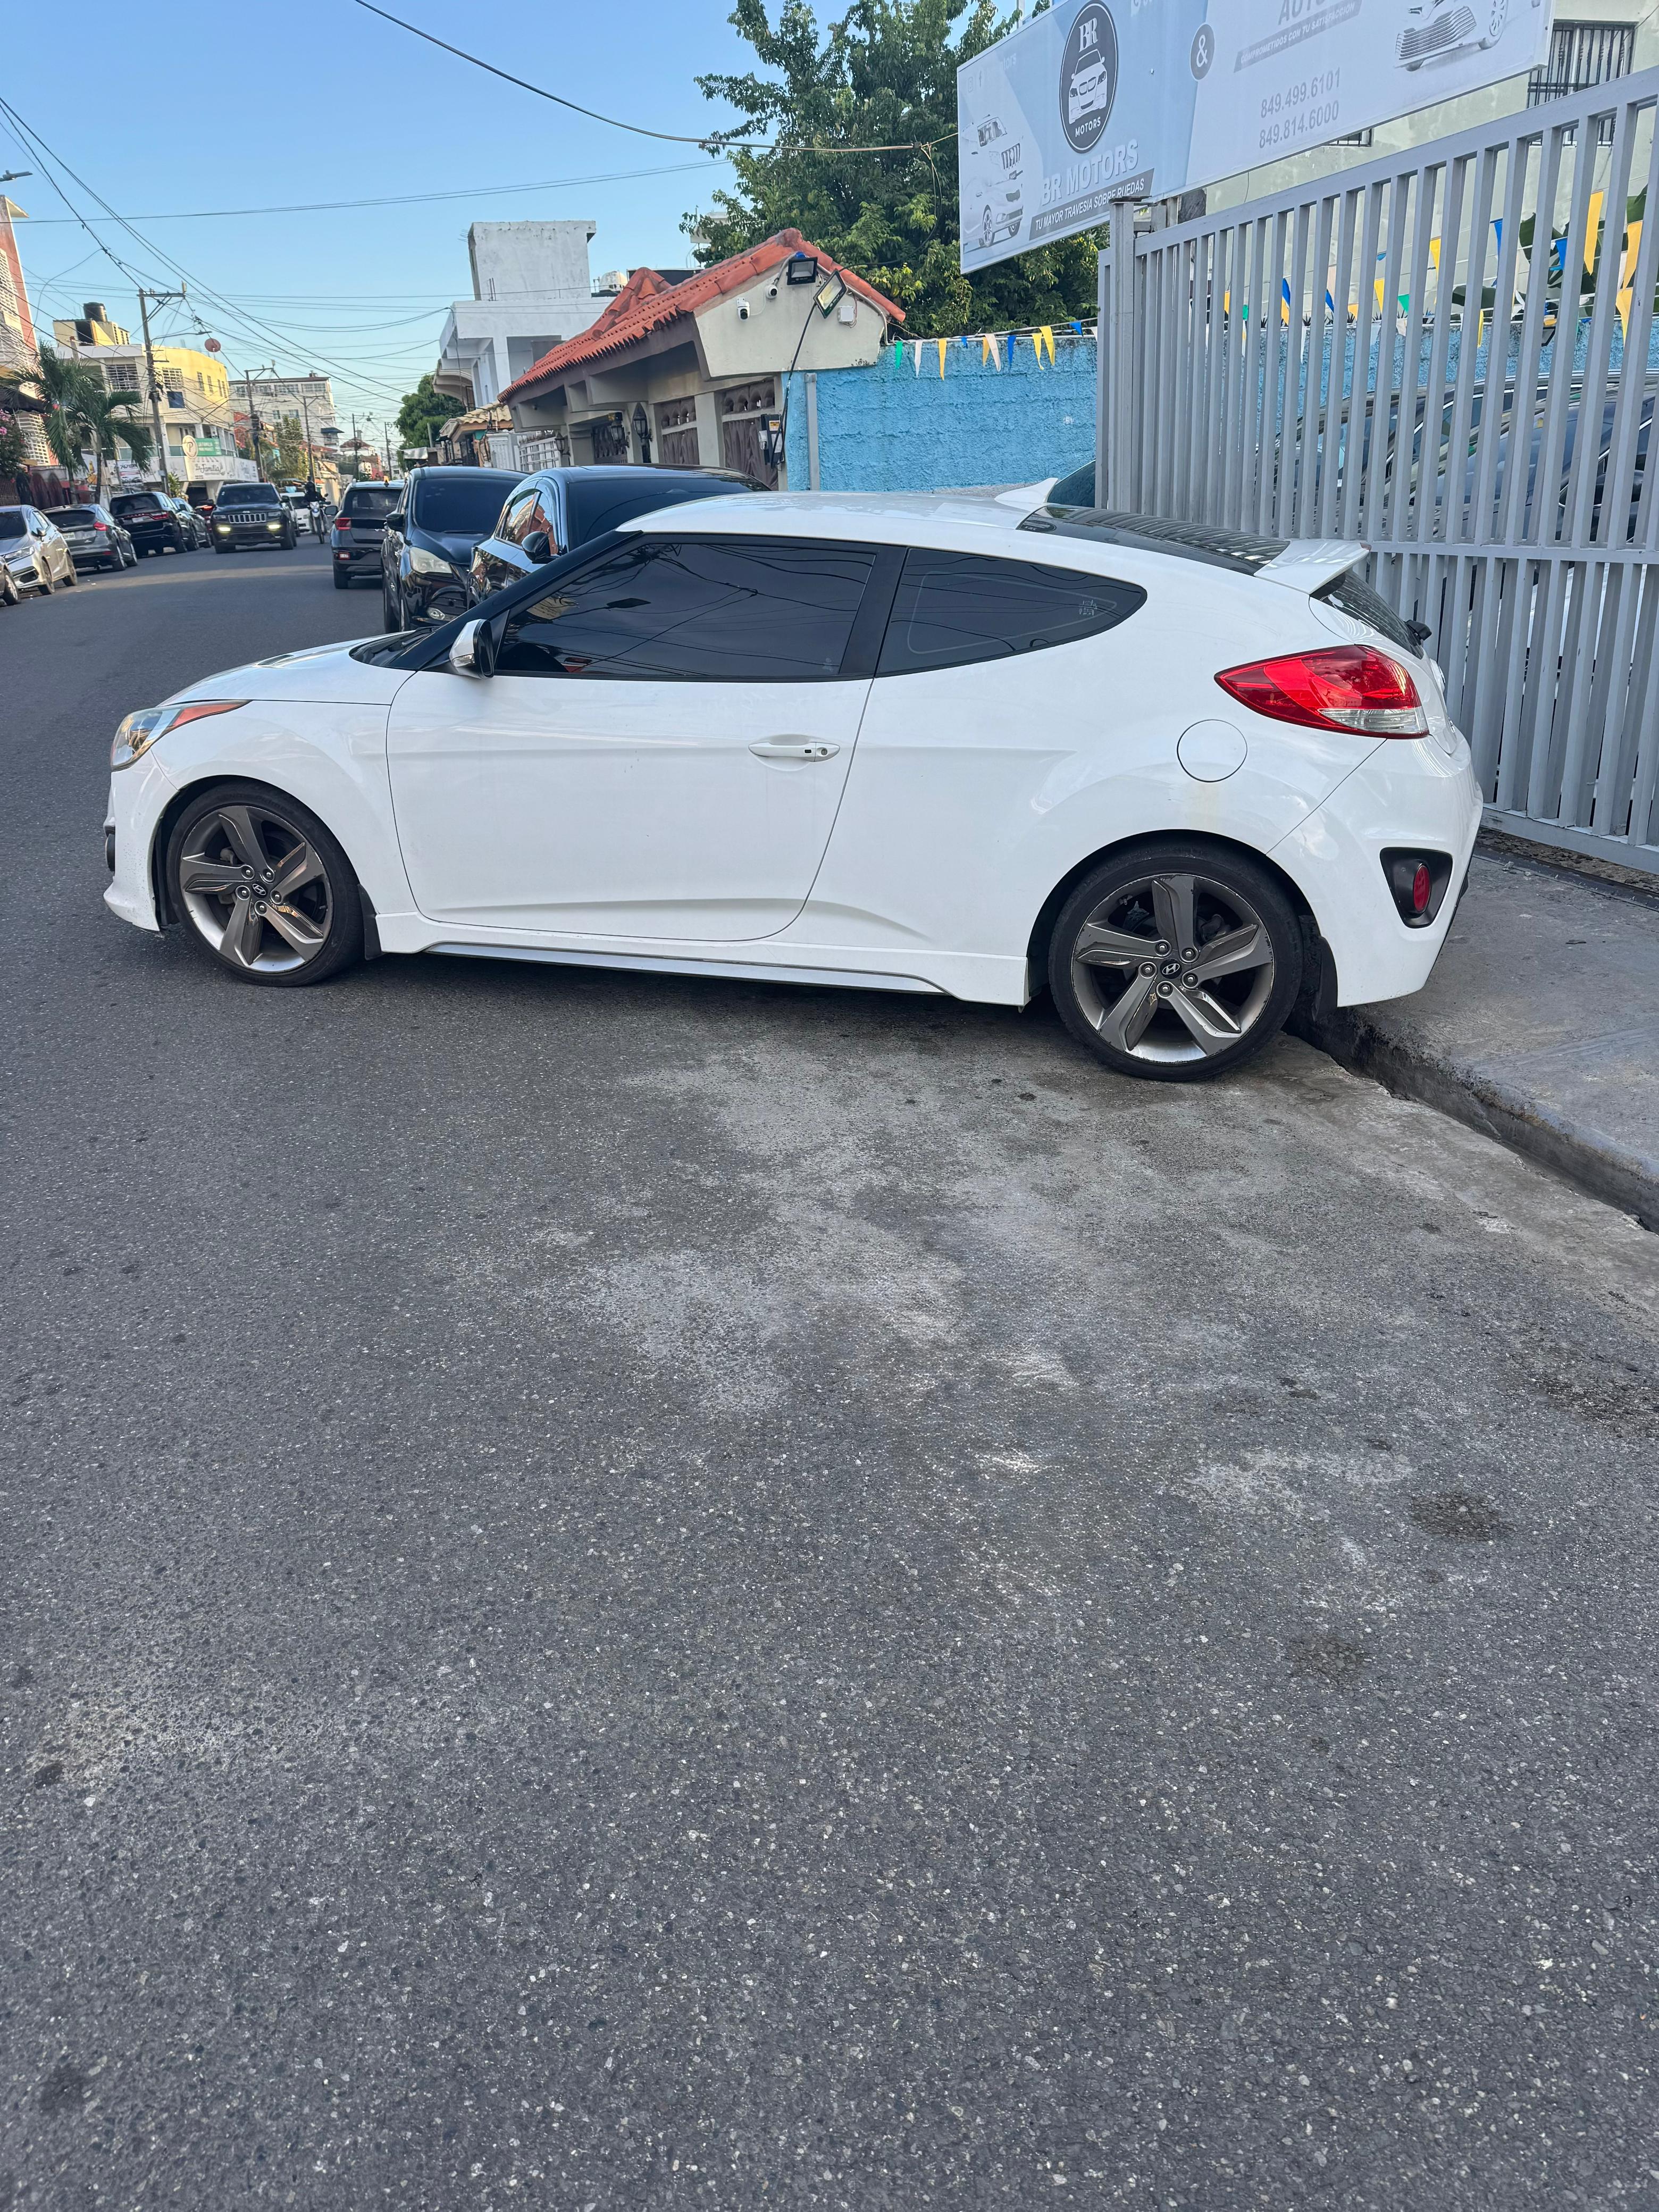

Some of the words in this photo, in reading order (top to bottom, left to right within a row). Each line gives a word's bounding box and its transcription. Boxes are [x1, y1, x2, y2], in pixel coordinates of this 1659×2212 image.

[1078, 18, 1099, 53] BR
[1241, 35, 1287, 63] COMPROMETIDOS
[1288, 28, 1301, 41] CON
[1302, 24, 1311, 35] TU
[1311, 3, 1355, 30] SATISFACCION
[1278, 0, 1325, 25] AU
[1196, 35, 1208, 68] &
[1261, 66, 1340, 119] 849.499.6101
[1075, 116, 1101, 138] MOTORS
[1259, 100, 1339, 149] 849.814.6000
[1042, 173, 1062, 206] BR
[1066, 139, 1139, 196] MOTORS
[1035, 219, 1043, 231] TU
[1043, 210, 1063, 227] MAYOR
[1065, 198, 1093, 220] TRAVESIA
[1094, 189, 1116, 208] SOBRE
[1117, 178, 1145, 197] RUEDAS
